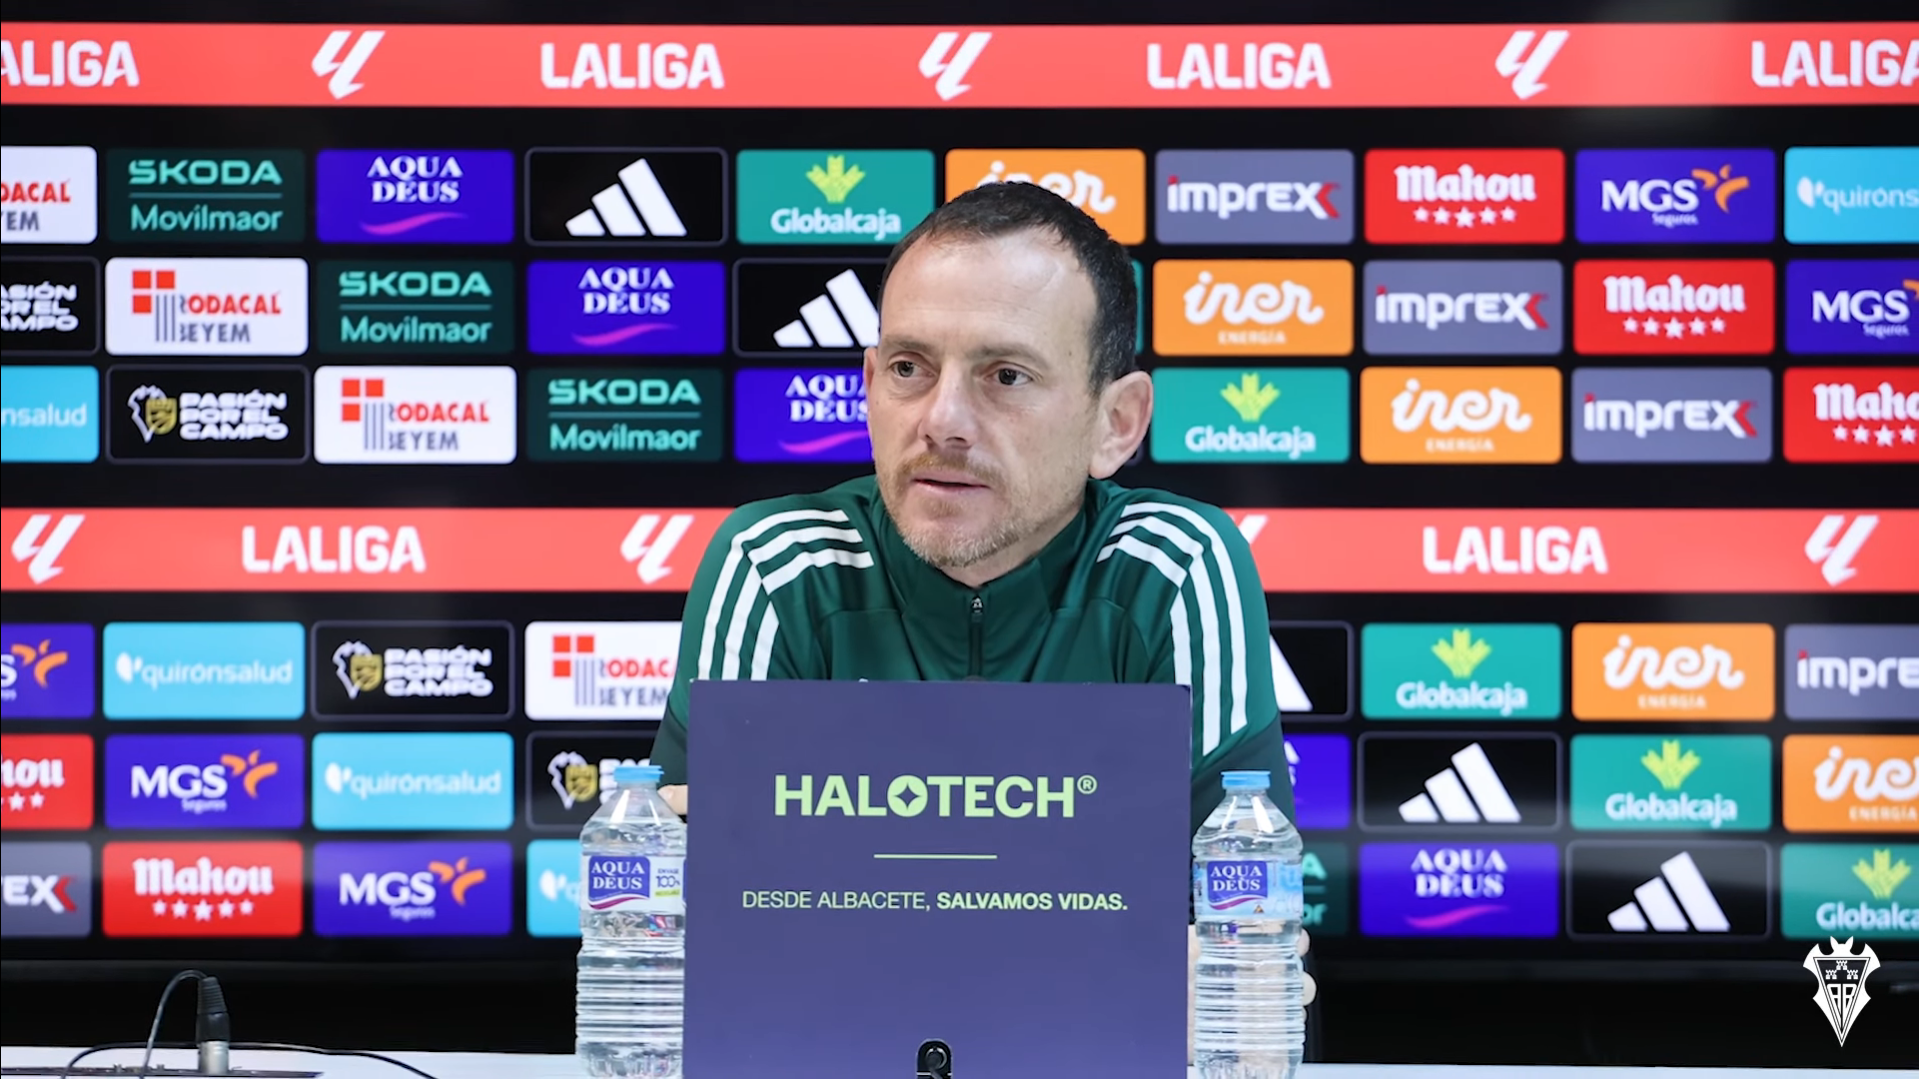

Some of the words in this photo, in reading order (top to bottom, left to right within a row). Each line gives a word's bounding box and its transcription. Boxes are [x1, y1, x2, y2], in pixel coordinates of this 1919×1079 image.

[1, 40, 139, 87] ALIGA
[541, 43, 725, 89] LALIGA
[1148, 43, 1331, 89] LALIGA
[367, 156, 463, 181] AQUA
[1394, 164, 1537, 202] Mahou
[1, 182, 71, 203] DACAL
[372, 181, 460, 203] DEUS
[1602, 180, 1699, 213] MGS
[1823, 184, 1919, 215] quiróns
[771, 207, 901, 240] Globalcaja
[578, 267, 674, 292] AQUA
[1603, 275, 1746, 312] Mahou
[583, 292, 671, 314] DEUS
[1812, 290, 1910, 323] MGS
[180, 389, 287, 410] PASIÓN
[1813, 382, 1919, 421] Maho
[180, 423, 289, 440] CAMPO
[1185, 425, 1316, 459] Globalcaja
[242, 526, 426, 573] LALIGA
[1423, 526, 1608, 574] LALIGA
[384, 645, 492, 667] PASIÓN
[384, 679, 493, 697] CAMPO
[1396, 681, 1528, 716] Globalcaja
[131, 764, 228, 798] MGS
[1814, 746, 1919, 801] ine
[1605, 792, 1738, 829] Globalcaja
[133, 856, 274, 895] Mahou
[591, 861, 645, 877] AQUA
[1211, 865, 1262, 880] AQUA
[1411, 849, 1507, 875] AQUA
[339, 871, 436, 906] MGS
[593, 877, 643, 890] DEUS
[1213, 879, 1261, 891] DEUS
[1415, 874, 1504, 898] DEUS
[742, 891, 812, 909] DESDE
[818, 892, 931, 912] ALBACETE,
[936, 892, 1053, 910] SALVAMOS
[1058, 893, 1128, 911] VIDAS.
[1816, 901, 1919, 931] Globalca
